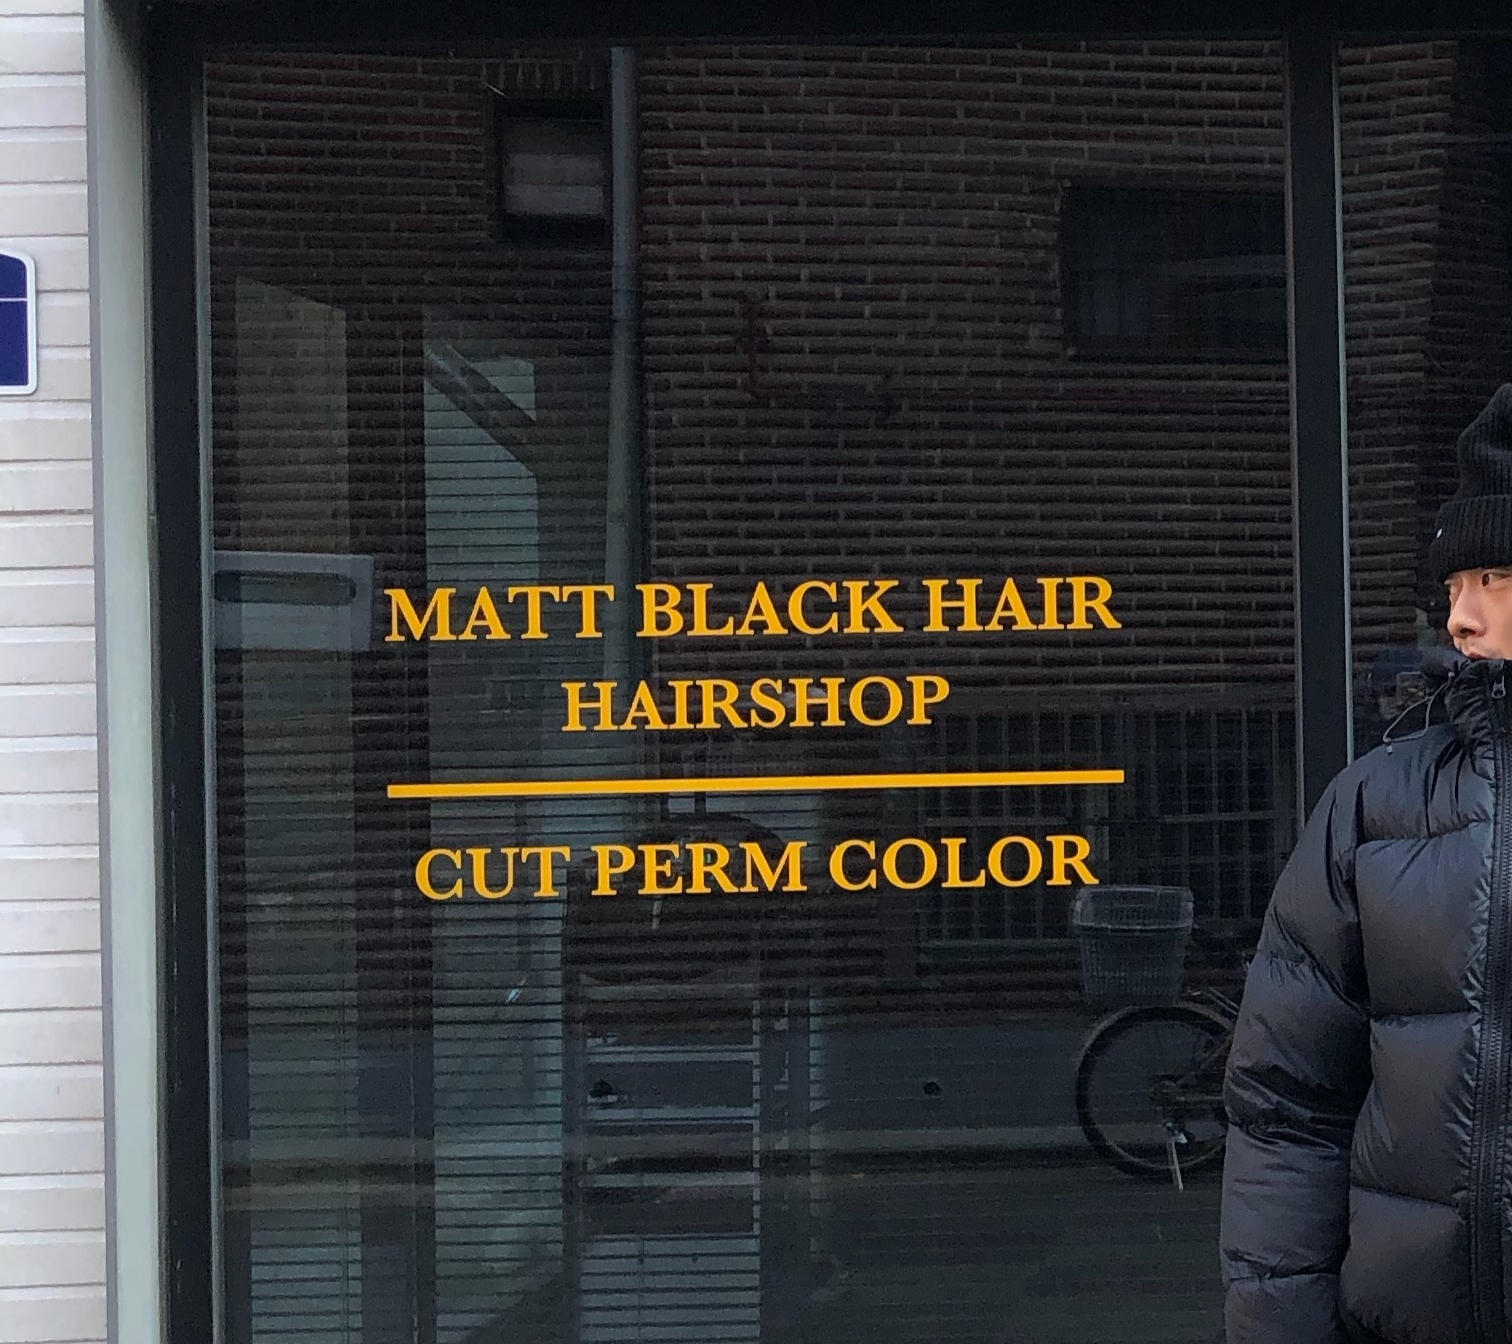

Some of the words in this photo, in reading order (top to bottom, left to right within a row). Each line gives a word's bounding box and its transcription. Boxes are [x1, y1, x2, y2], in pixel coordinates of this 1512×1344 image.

[385, 585, 615, 642] MATT
[636, 579, 903, 637] BLACK
[923, 576, 1122, 633] HAIR
[562, 675, 950, 732] HAIRSHOP
[415, 845, 571, 900] CUT
[592, 840, 806, 896] PERM
[829, 834, 1099, 891] COLOR
